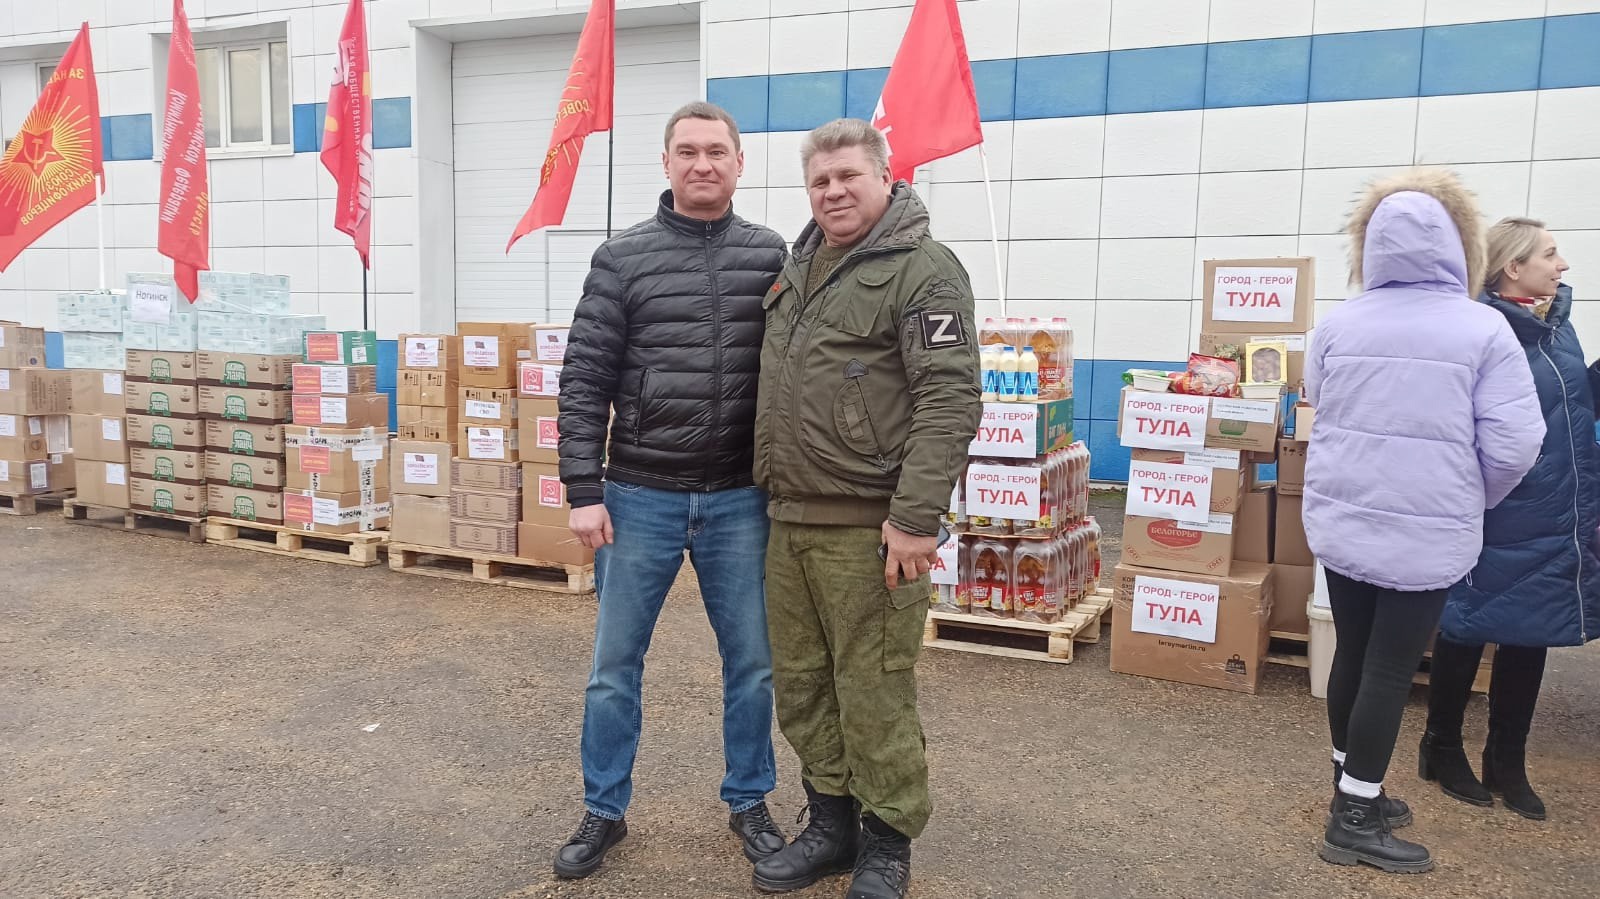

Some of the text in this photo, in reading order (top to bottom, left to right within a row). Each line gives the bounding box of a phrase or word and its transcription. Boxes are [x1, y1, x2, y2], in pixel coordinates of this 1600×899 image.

[1217, 275, 1251, 286] ГОРОД
[1259, 276, 1293, 285] ГЕРОЙ
[1226, 292, 1281, 308] ТУЛА
[928, 314, 958, 343] Z
[1127, 400, 1162, 413] ГОРОД
[1170, 404, 1205, 415] ГЕРОЙ
[1003, 412, 1033, 421] ГЕРОЙ
[1135, 417, 1192, 438] ТУЛА
[969, 472, 999, 483] ГОРОД
[1007, 474, 1038, 485] ГЕРОЙ
[1132, 469, 1166, 481] ГОРОД
[1174, 473, 1208, 485] ГЕРОЙ
[977, 488, 1028, 506] ТУЛА
[1140, 486, 1197, 508] ТУЛА
[1137, 585, 1172, 597] ГОРОД
[1180, 591, 1215, 602] ГЕРОЙ
[1145, 602, 1203, 626] ТУЛА
